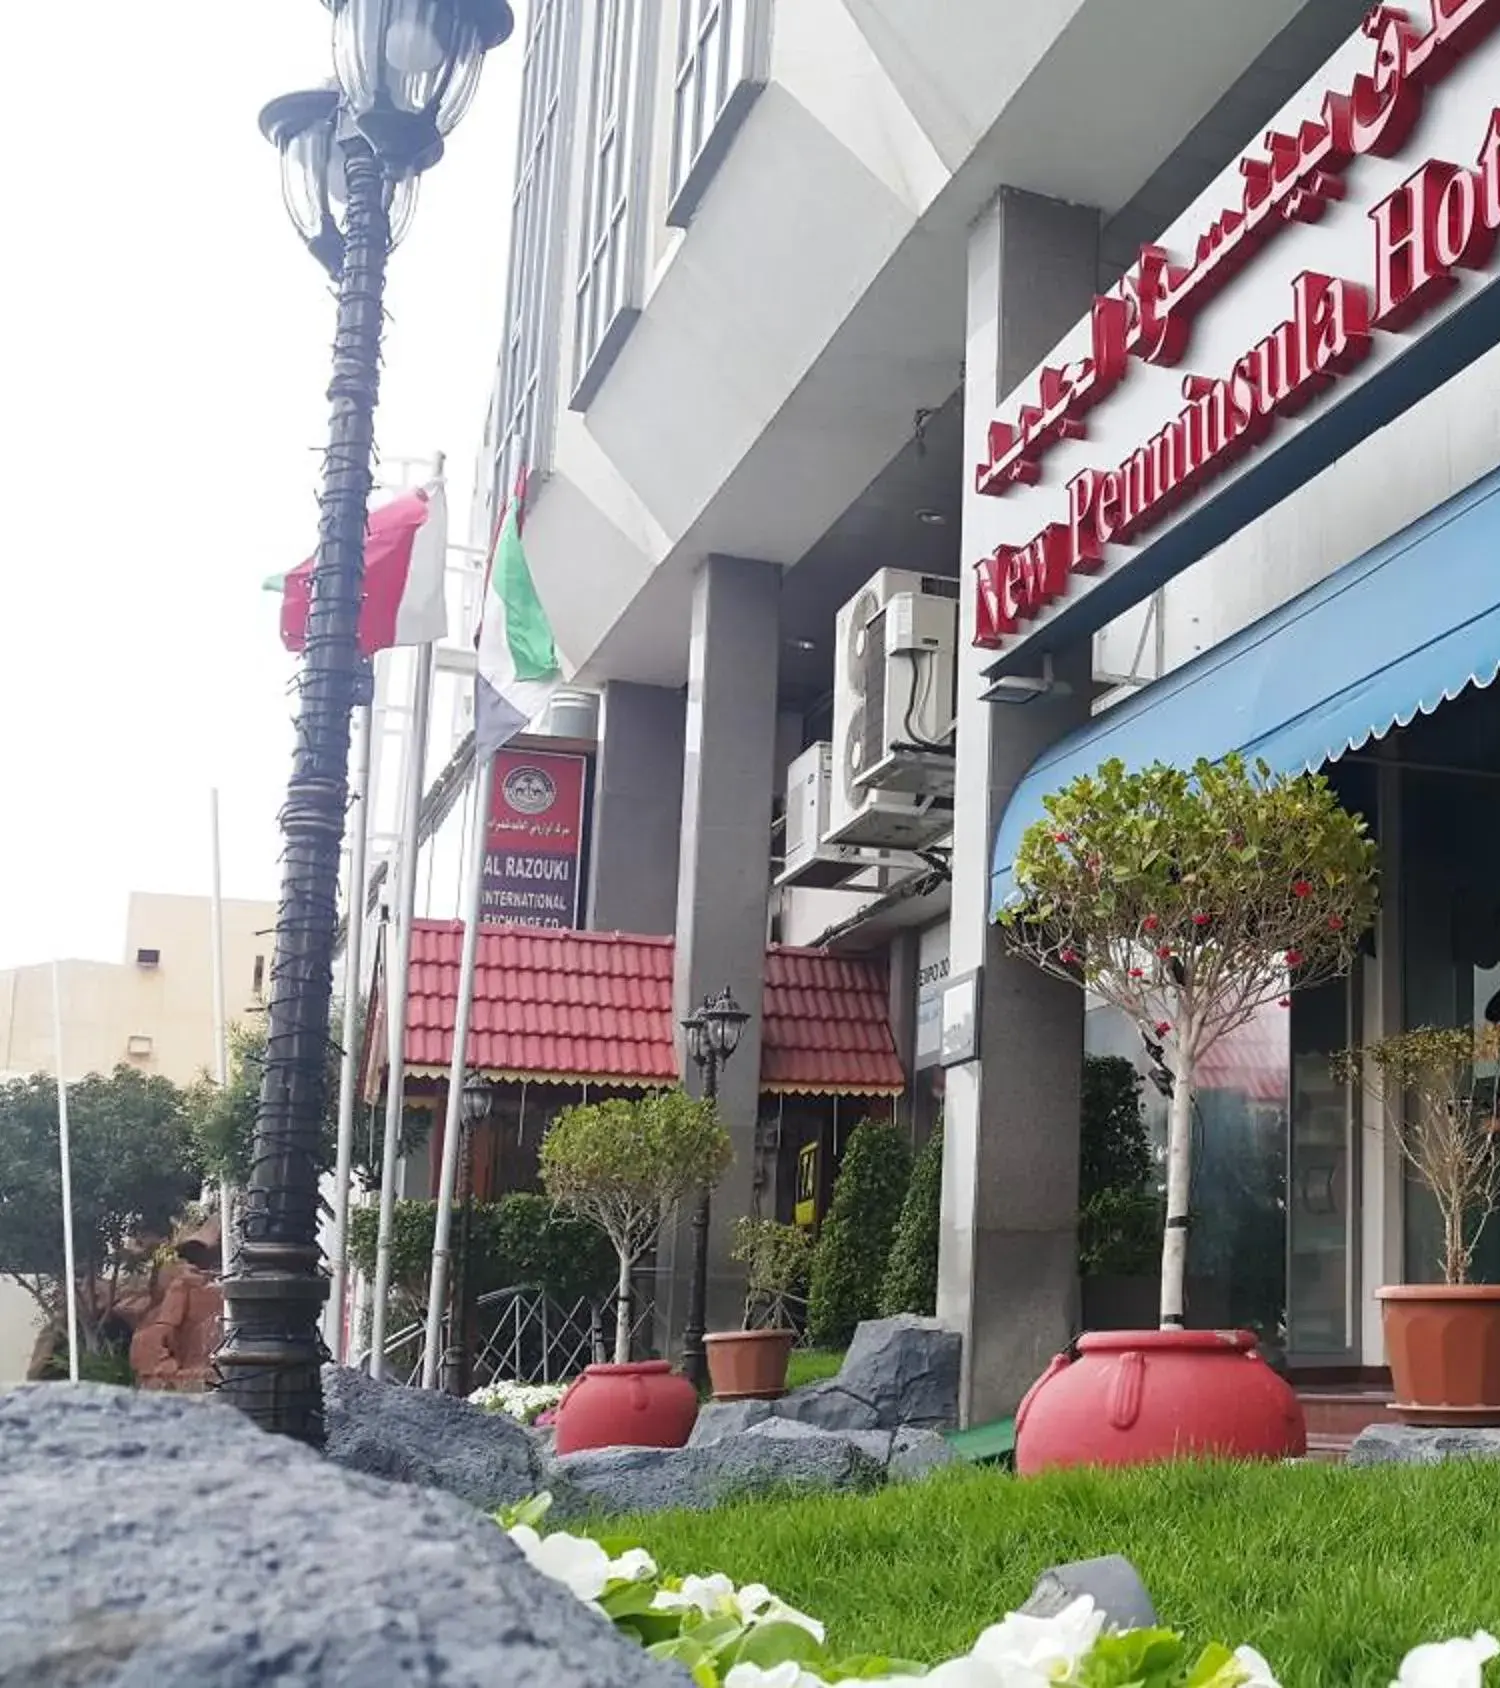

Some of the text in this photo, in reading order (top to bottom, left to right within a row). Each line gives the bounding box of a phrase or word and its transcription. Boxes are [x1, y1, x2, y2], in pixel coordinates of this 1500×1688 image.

[972, 524, 1064, 648] New
[1066, 270, 1360, 574] Penninsula
[976, 295, 1126, 496] الجديد
[483, 855, 569, 881] AL RAZOUKI
